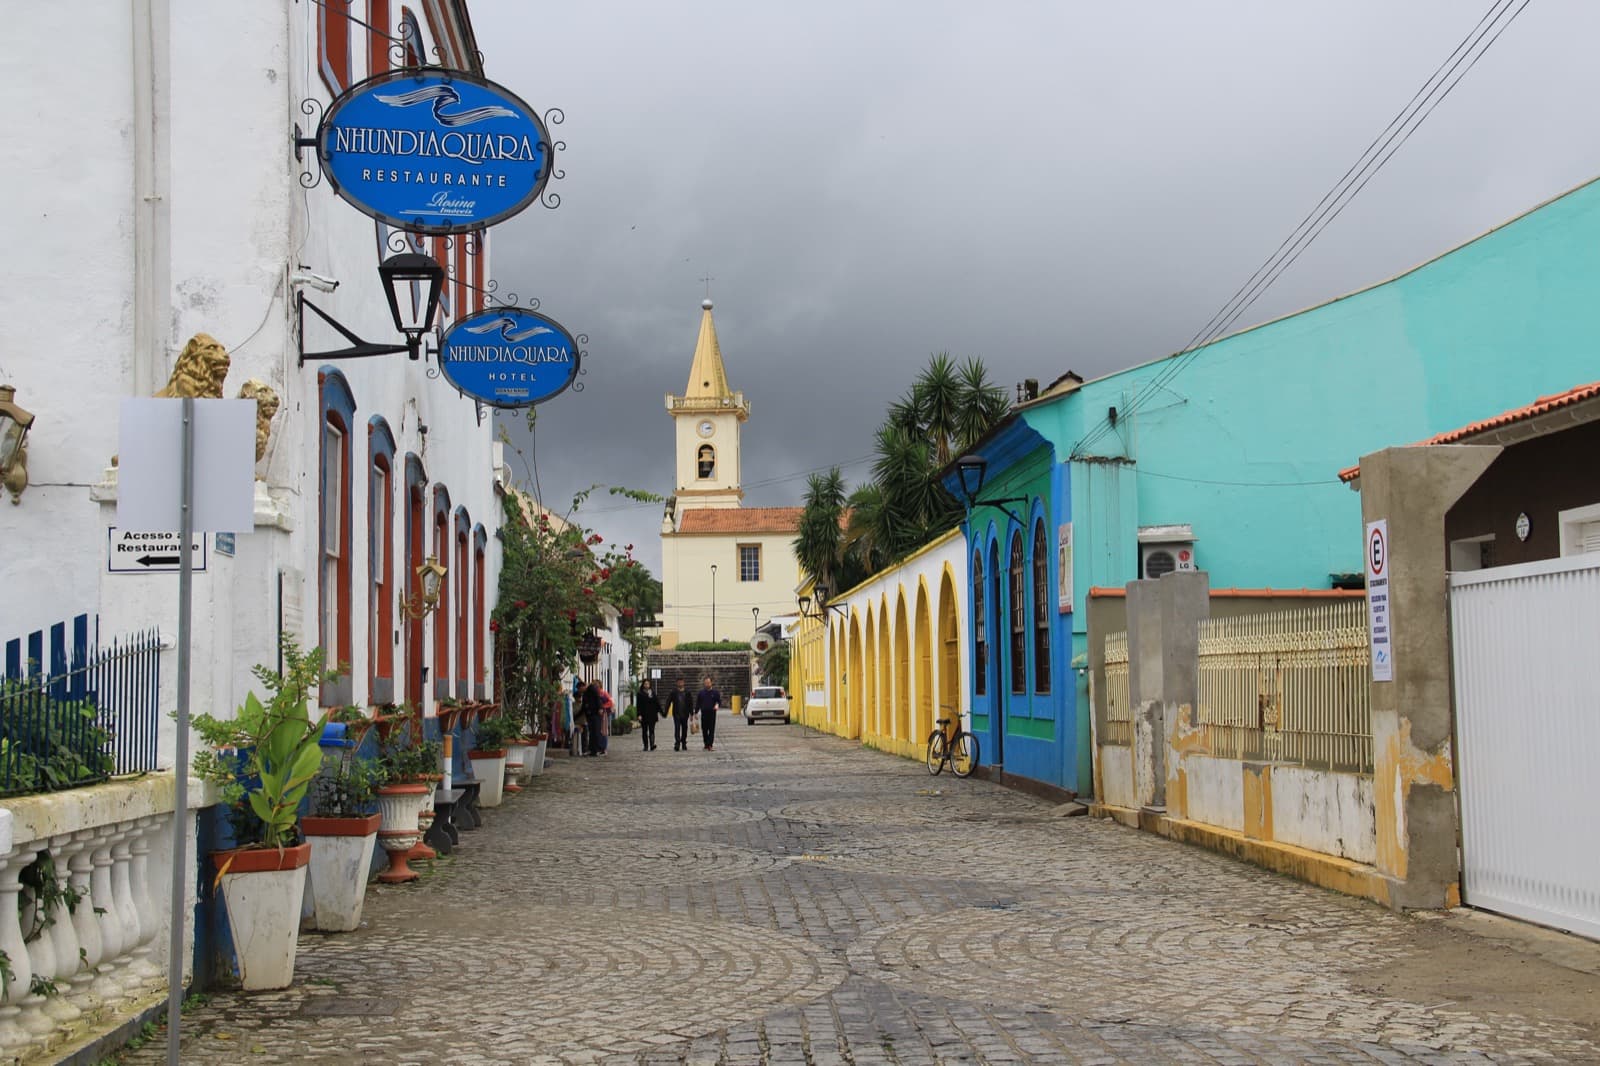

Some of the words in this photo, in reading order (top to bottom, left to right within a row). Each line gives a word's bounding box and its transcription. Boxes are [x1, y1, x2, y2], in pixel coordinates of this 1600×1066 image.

[335, 127, 535, 165] NHUNDIAQUARA
[363, 169, 506, 187] RESTAURANTE
[426, 190, 476, 208] Rosina
[448, 346, 569, 366] NHUNDIAQUARA
[488, 373, 537, 381] HOTEL
[123, 531, 172, 540] Acesso
[117, 543, 199, 552] Restaurae
[1373, 539, 1380, 565] E
